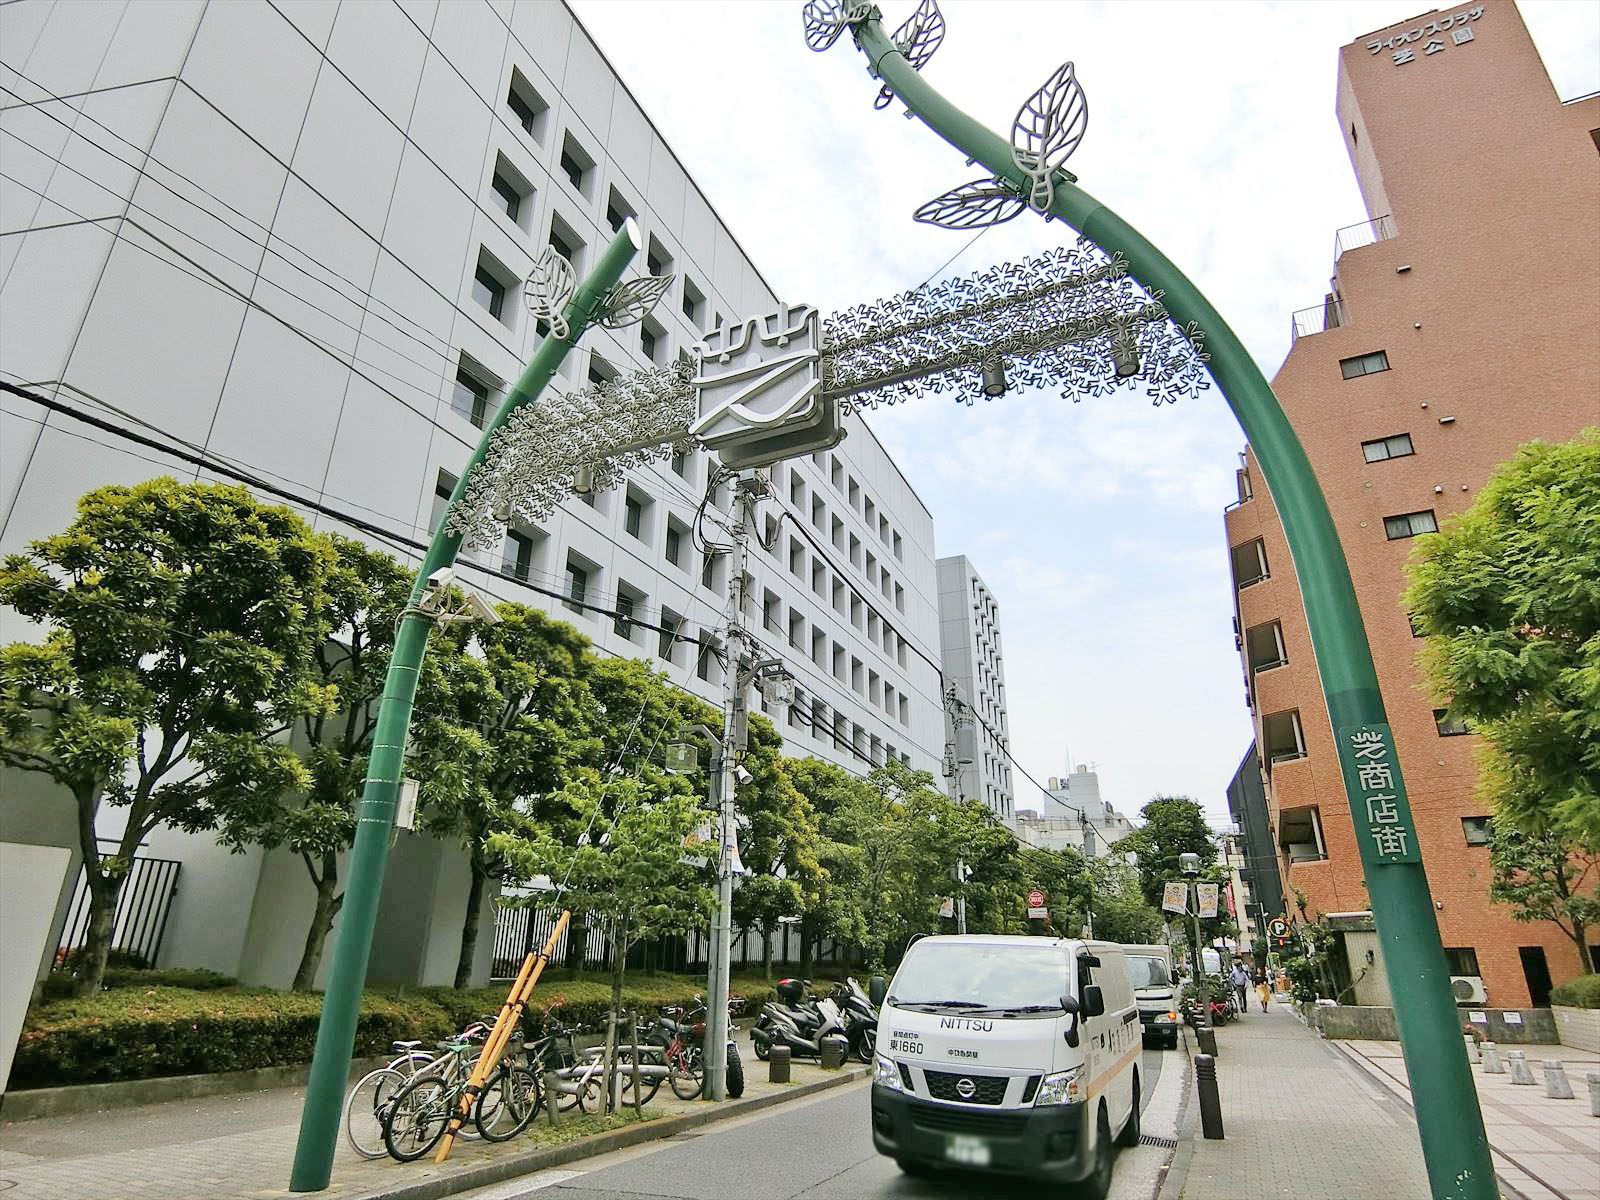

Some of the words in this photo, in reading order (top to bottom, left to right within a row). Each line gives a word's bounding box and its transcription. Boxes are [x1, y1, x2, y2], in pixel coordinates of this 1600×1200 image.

[1366, 5, 1485, 56] ライオンスプラザ
[1350, 730, 1408, 857] 芝商店街
[1274, 922, 1286, 935] P
[940, 1017, 993, 1033] NITTSU
[889, 1039, 924, 1055] 東1660
